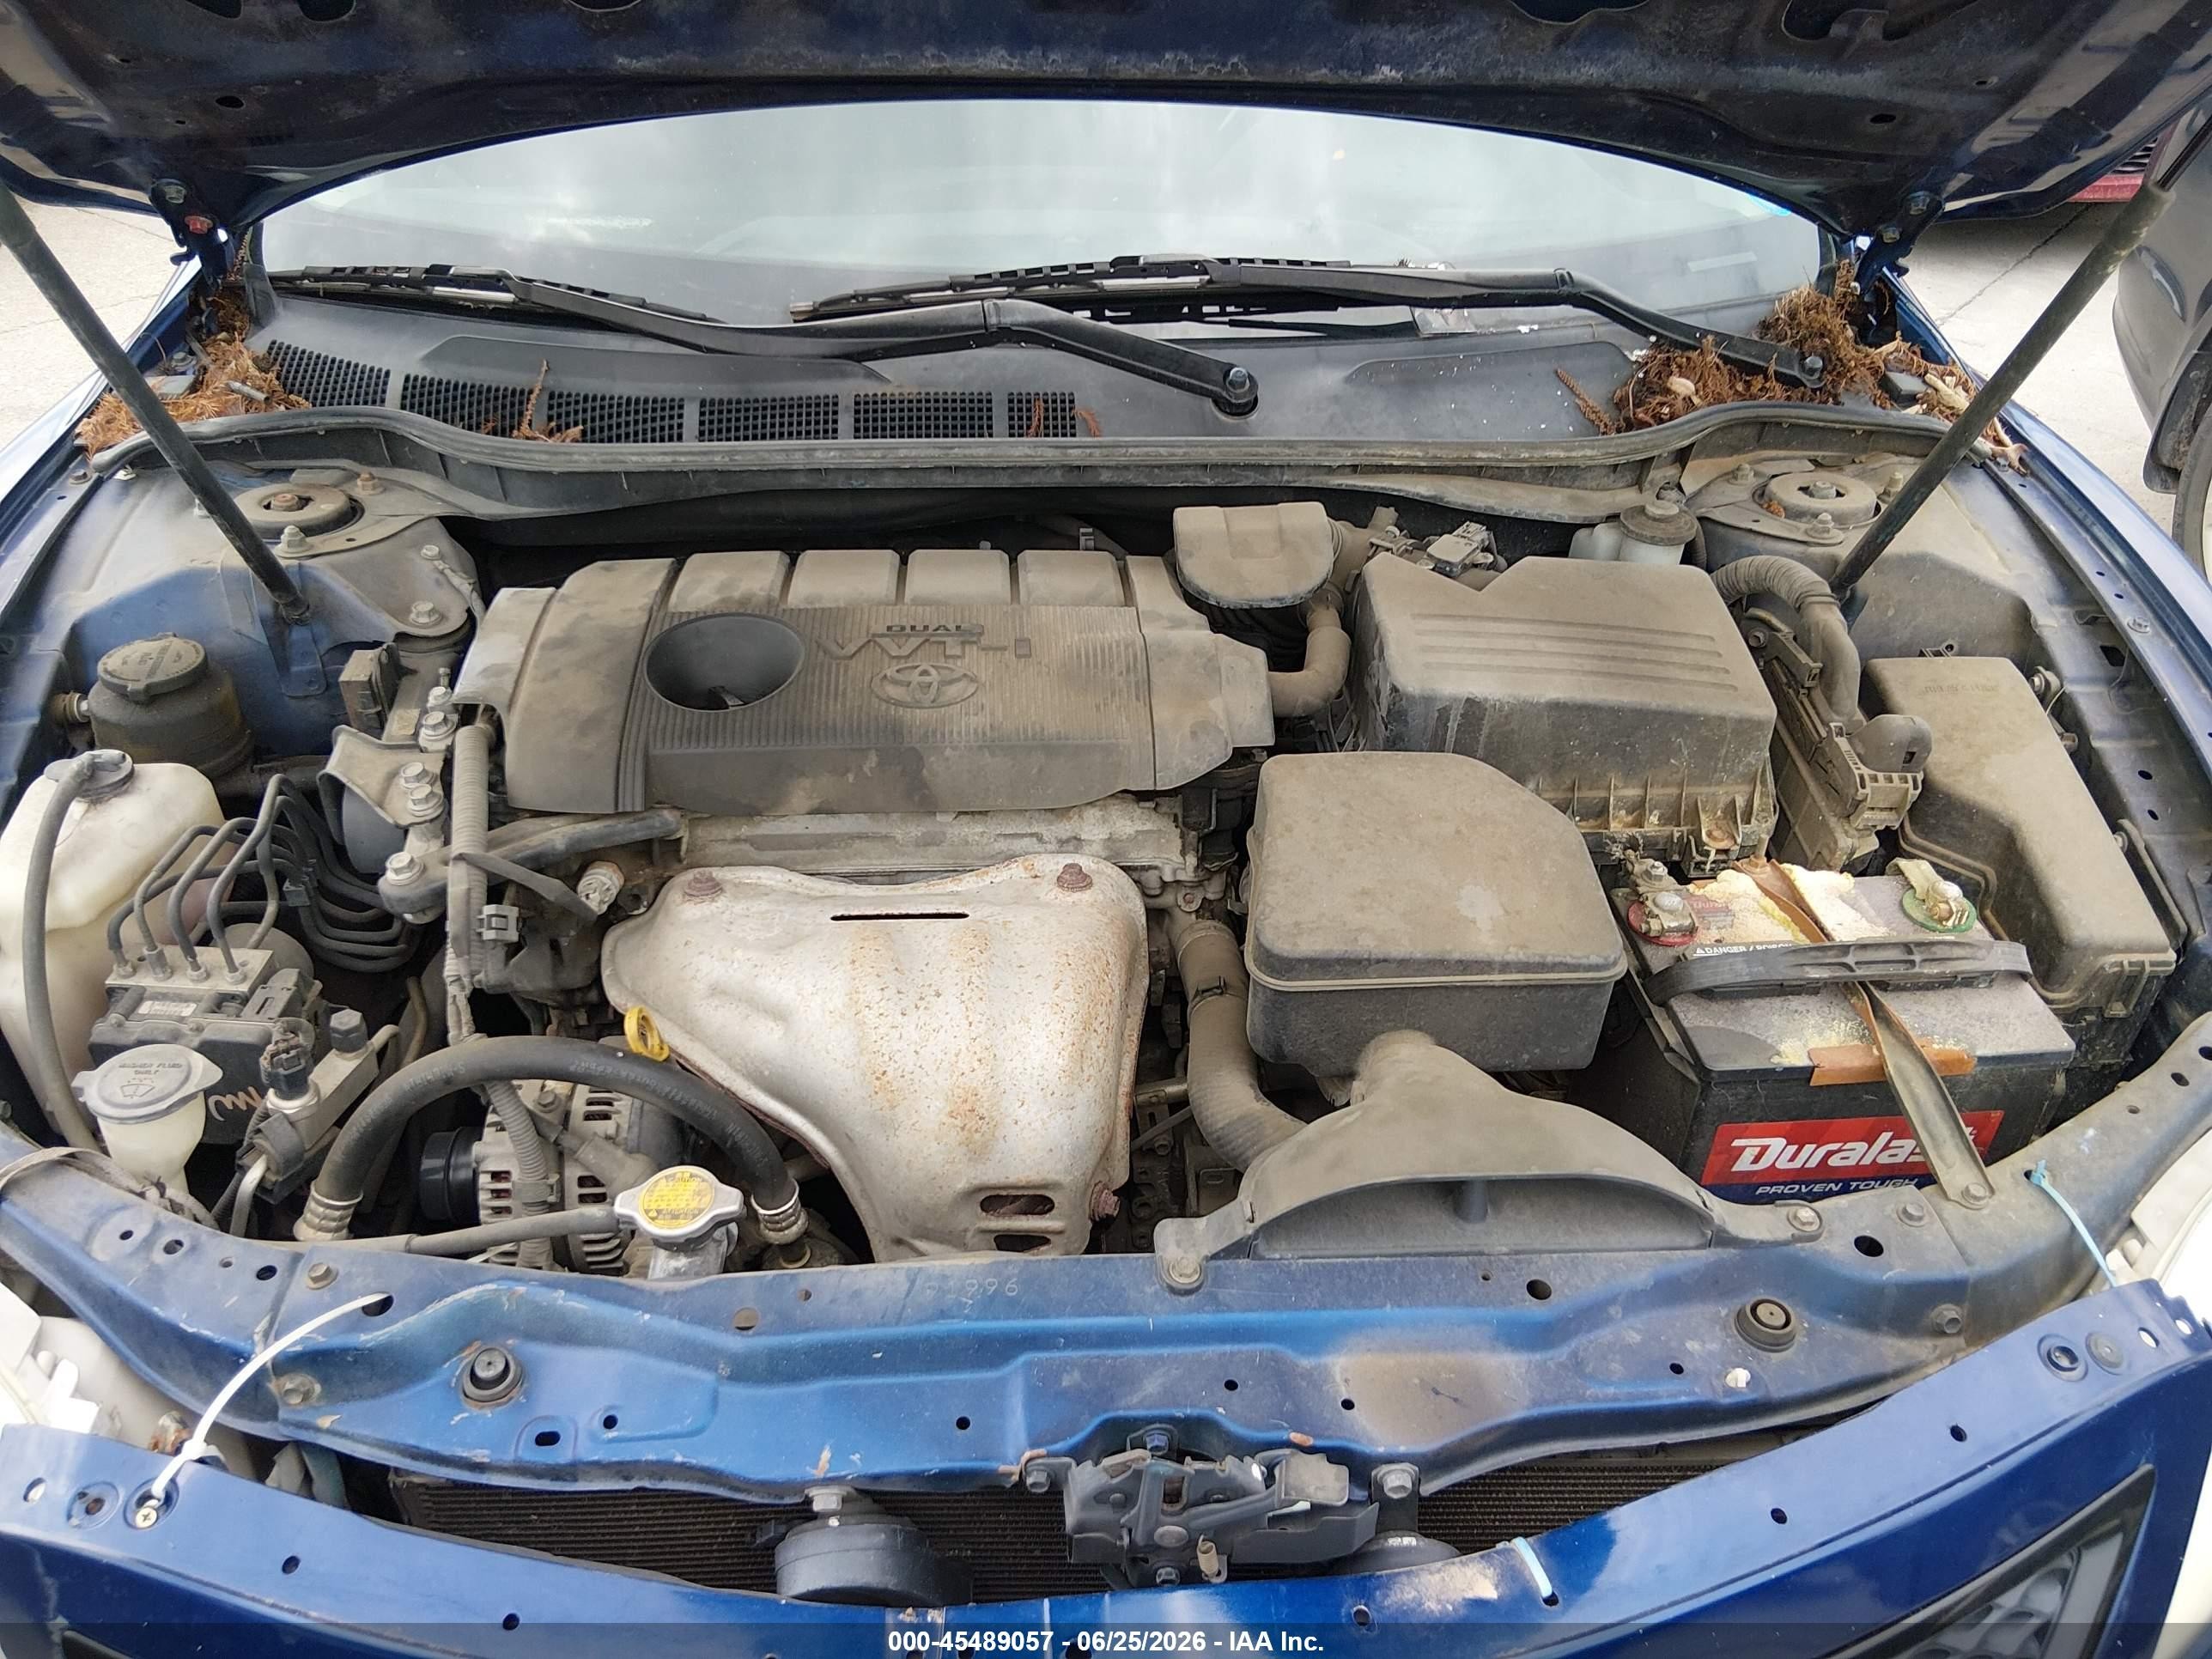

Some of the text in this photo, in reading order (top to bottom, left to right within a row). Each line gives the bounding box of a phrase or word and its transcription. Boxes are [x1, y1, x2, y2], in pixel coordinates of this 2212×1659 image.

[885, 623, 975, 633] DUAL
[1704, 945, 1747, 955] DANGER
[1755, 1177, 1919, 1196] PROVEN TOUGH
